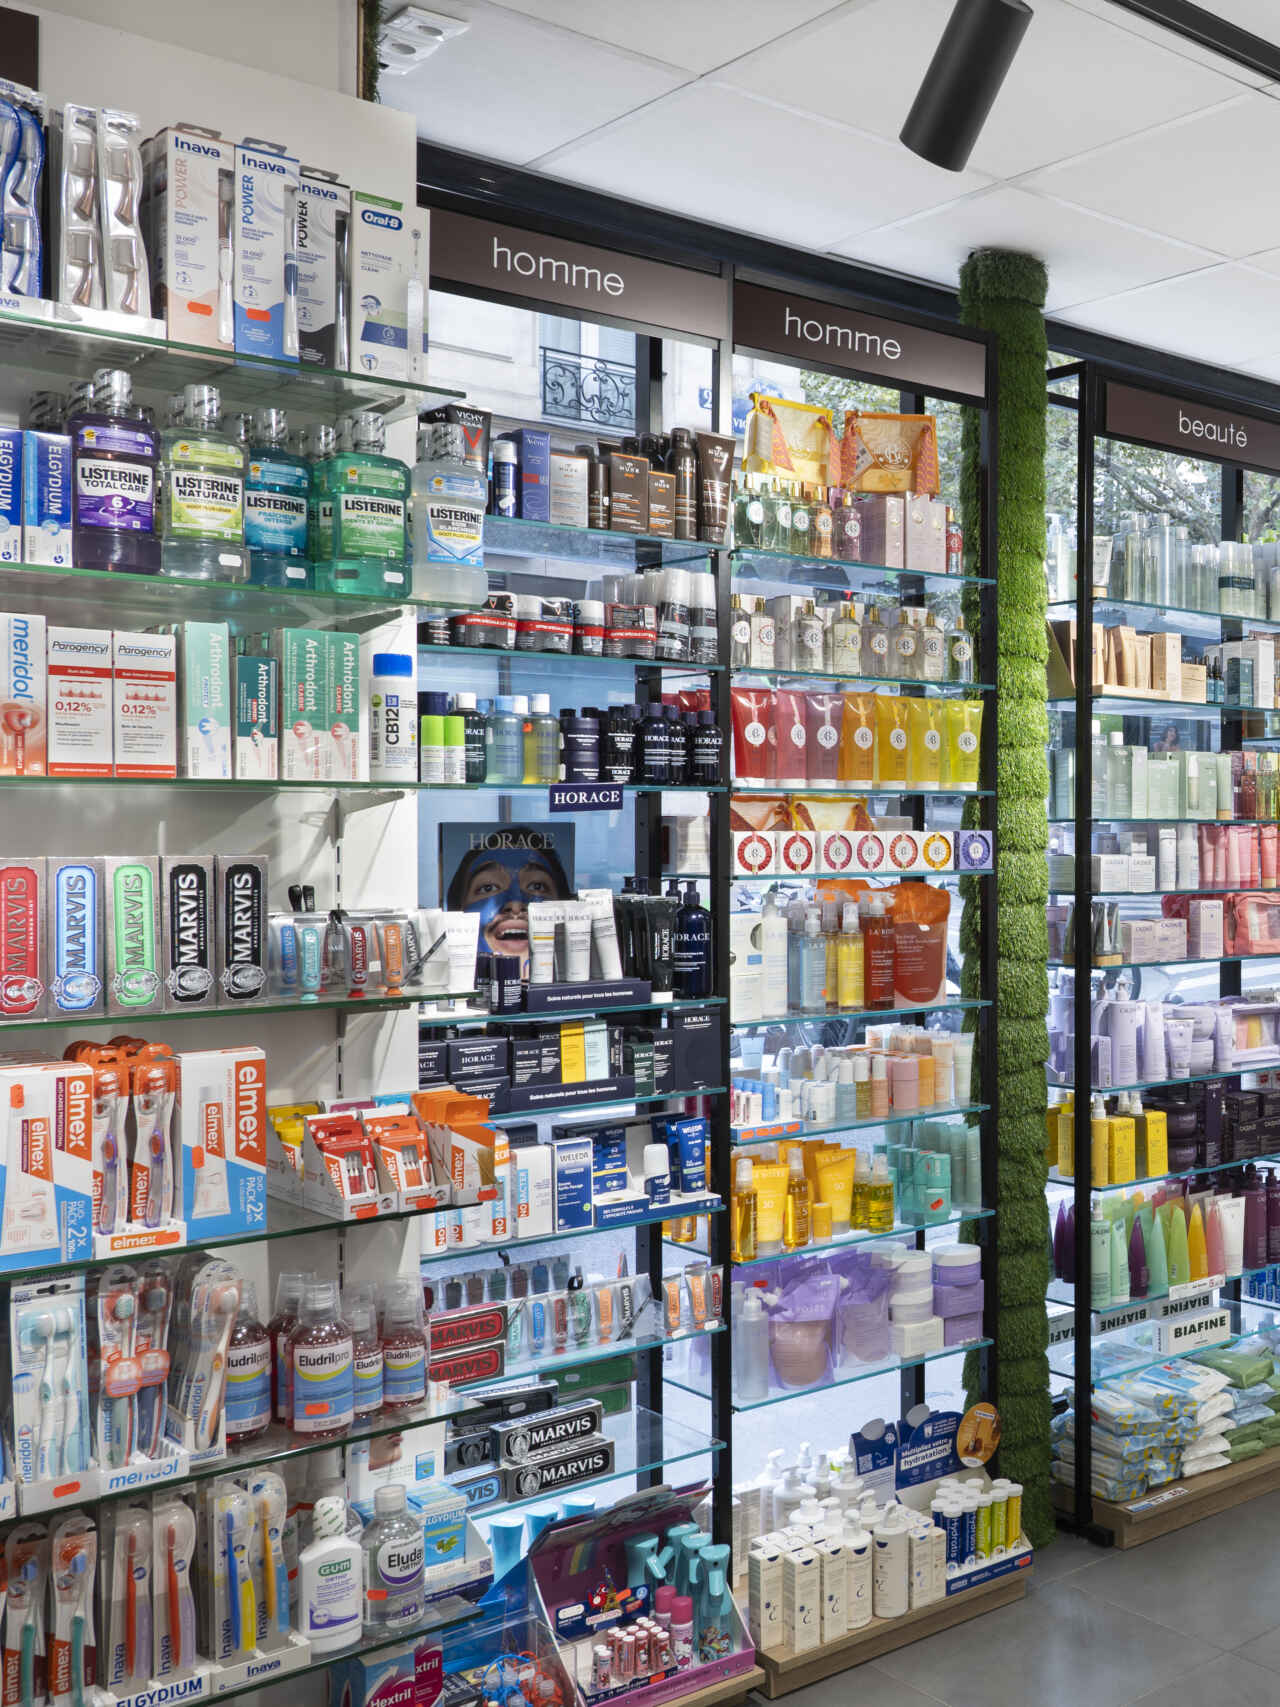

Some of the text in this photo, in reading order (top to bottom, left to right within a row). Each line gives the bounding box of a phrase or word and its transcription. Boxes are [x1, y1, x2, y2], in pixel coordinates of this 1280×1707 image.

[174, 136, 221, 159] Inava
[242, 154, 287, 174] Inava
[176, 158, 188, 209] POWER
[242, 175, 254, 224] POWER
[298, 201, 309, 248] POWER
[363, 211, 400, 229] Oral-B
[493, 236, 625, 297] homme
[785, 307, 902, 360] homme
[456, 410, 484, 423] VICHY
[1179, 411, 1248, 448] beauté
[0, 440, 13, 511] ELGYDIUM
[48, 445, 62, 515] ELGYDIUM
[81, 466, 150, 486] LISTERINE
[84, 479, 147, 494] TOTAL CARE
[175, 475, 240, 495] LISTERINE
[111, 496, 123, 508] 6
[178, 489, 238, 503] NATURALS
[247, 496, 304, 514] LISTERINE
[345, 500, 402, 515] LISTERINE
[430, 507, 482, 524] LISTERINE
[13, 618, 34, 702] meridol
[52, 640, 109, 655] Paragencyl
[118, 645, 172, 658] Paragencyl
[208, 633, 223, 708] Arthrodont
[305, 639, 318, 711] Arthrodont
[343, 641, 353, 714] Arthrodont
[258, 663, 269, 724] Arthrodont
[385, 708, 399, 745] CB12
[464, 728, 485, 736] ORACE
[644, 735, 669, 743] HORACE
[695, 737, 723, 745] HORACE
[554, 791, 620, 805] HORACE
[468, 832, 556, 850] HORACE
[7, 877, 27, 972] MARVIS
[67, 875, 86, 969] MARVIS
[124, 874, 145, 966] MARVIS
[179, 872, 198, 964] MARVIS
[235, 872, 252, 961] MARVIS
[661, 929, 669, 961] HORACE
[685, 1016, 710, 1024] HORACE
[462, 1054, 496, 1064] HORACE
[69, 1080, 86, 1150] elmex
[239, 1066, 263, 1151] elmex
[207, 1106, 218, 1150] elmex
[31, 1121, 44, 1172] elmex
[560, 1151, 589, 1163] WELEDA
[454, 1152, 464, 1192] elmex
[136, 1171, 147, 1217] elmex
[113, 1234, 157, 1249] elmex
[1100, 1308, 1147, 1331] BIAFINE
[1163, 1295, 1210, 1317] BIAFINE
[1173, 1315, 1227, 1339] BIAFINE
[228, 1350, 270, 1369] ludrilpro
[299, 1352, 350, 1368] Eludrilpro
[532, 1417, 591, 1445] MARVIS
[18, 1437, 32, 1483] meridol
[542, 1455, 604, 1483] MARVIS
[903, 1446, 949, 1468] hydratation
[466, 1483, 495, 1501] VIS
[388, 1548, 422, 1569] Eluda
[256, 1602, 268, 1640] Inava
[220, 1618, 231, 1660] Inava
[56, 1645, 71, 1692] elmex
[110, 1643, 125, 1685] Inava
[158, 1635, 170, 1676] Inava
[247, 1660, 281, 1678] Inava
[415, 1657, 440, 1675] xtril
[6, 1655, 19, 1702] elmex
